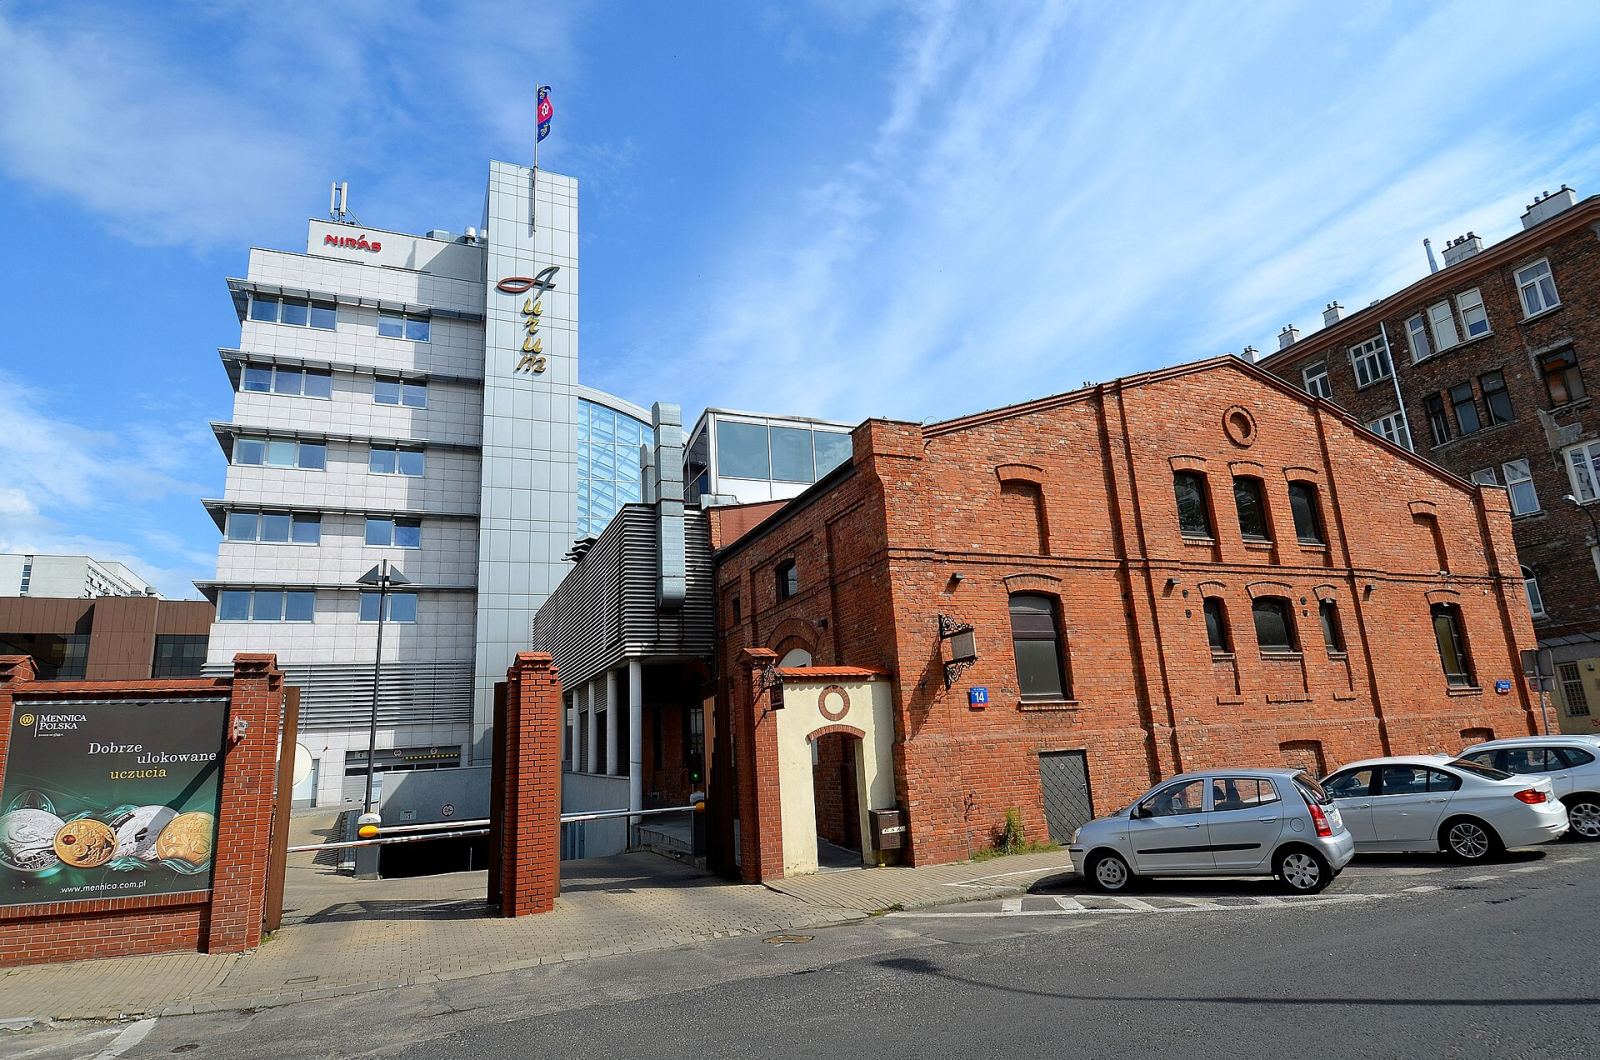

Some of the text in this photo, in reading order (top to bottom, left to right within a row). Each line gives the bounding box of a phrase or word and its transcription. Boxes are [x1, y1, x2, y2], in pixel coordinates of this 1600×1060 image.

[497, 266, 560, 373] Aurum
[974, 691, 985, 703] 14
[40, 714, 87, 723] MENNICA
[39, 722, 78, 731] POLSKA
[88, 742, 143, 755] Dobrze
[136, 751, 217, 764] ulokowane
[110, 766, 167, 780] uczucia
